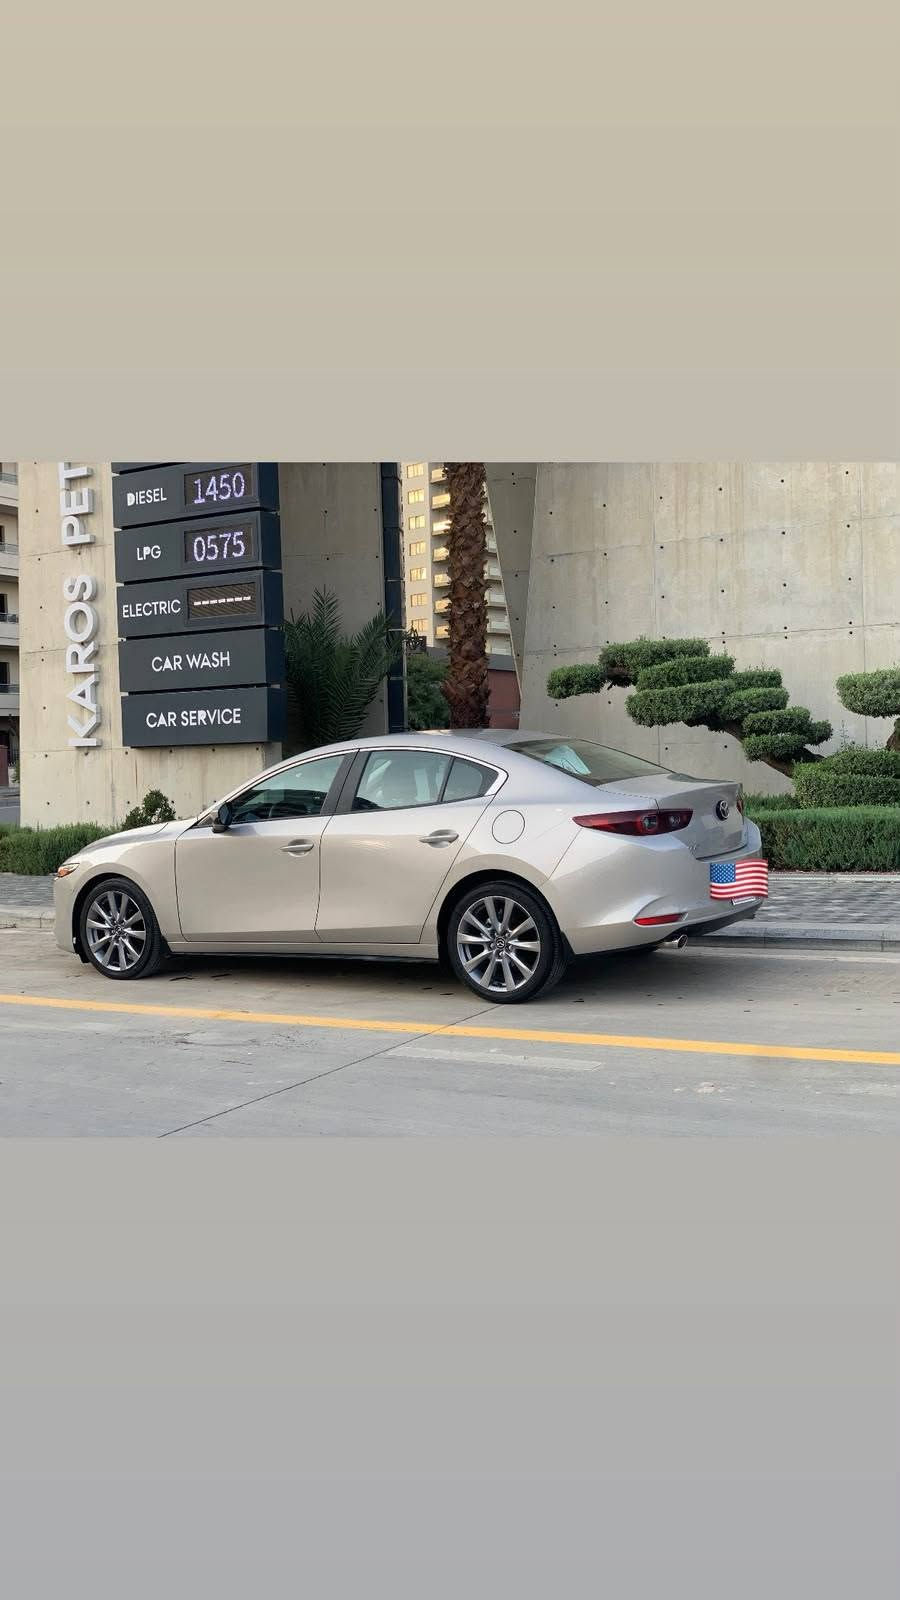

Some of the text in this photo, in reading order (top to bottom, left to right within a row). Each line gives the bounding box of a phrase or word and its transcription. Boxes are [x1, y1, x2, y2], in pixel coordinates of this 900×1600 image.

[126, 487, 167, 506] DIESEL
[193, 472, 245, 504] 1450
[136, 545, 162, 561] LPG
[193, 531, 246, 562] 0575
[122, 599, 181, 618] ELECTRIC
[64, 574, 100, 747] KAROS
[151, 651, 231, 672] CAR WASH
[146, 708, 242, 728] CAR SERVICE
